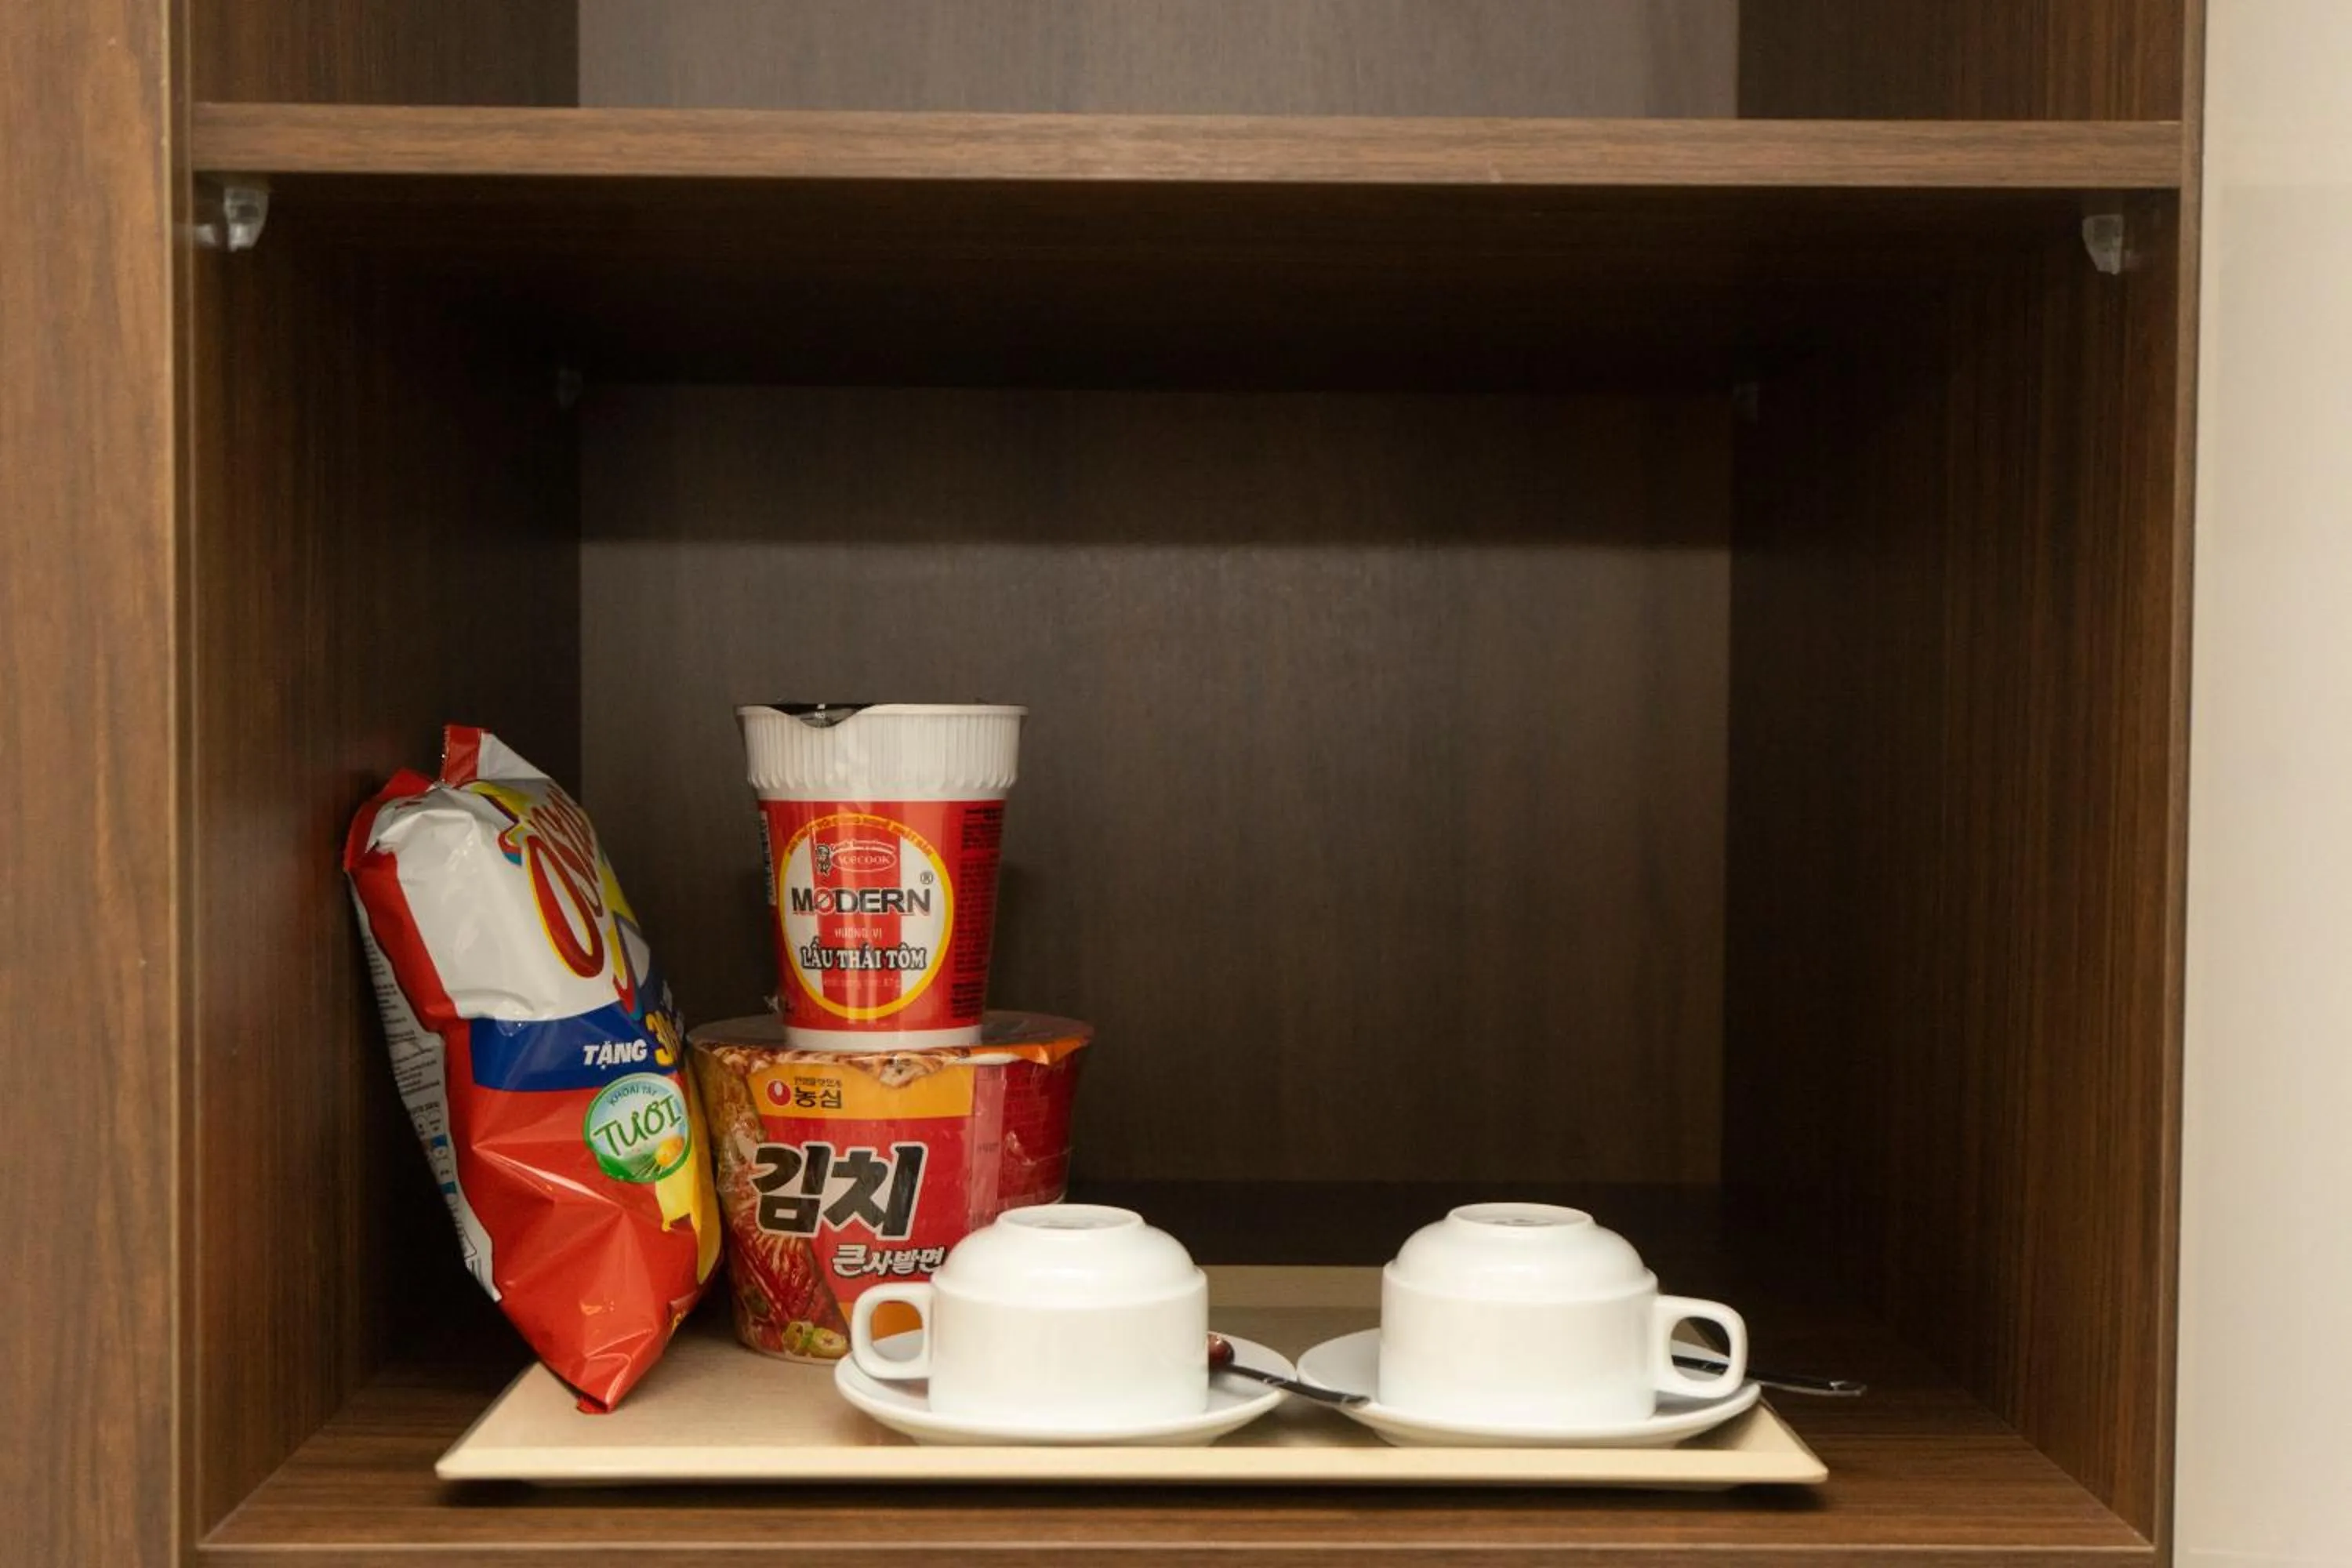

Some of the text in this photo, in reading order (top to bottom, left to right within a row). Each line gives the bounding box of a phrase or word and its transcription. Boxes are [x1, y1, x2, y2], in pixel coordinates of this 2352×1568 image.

[836, 943, 882, 970] THÁI
[884, 942, 927, 970] TÔM
[583, 1038, 648, 1070] TẶNG
[795, 1087, 841, 1109] 농심
[751, 1143, 927, 1239] 김치
[832, 1243, 945, 1276] 큰사발면
